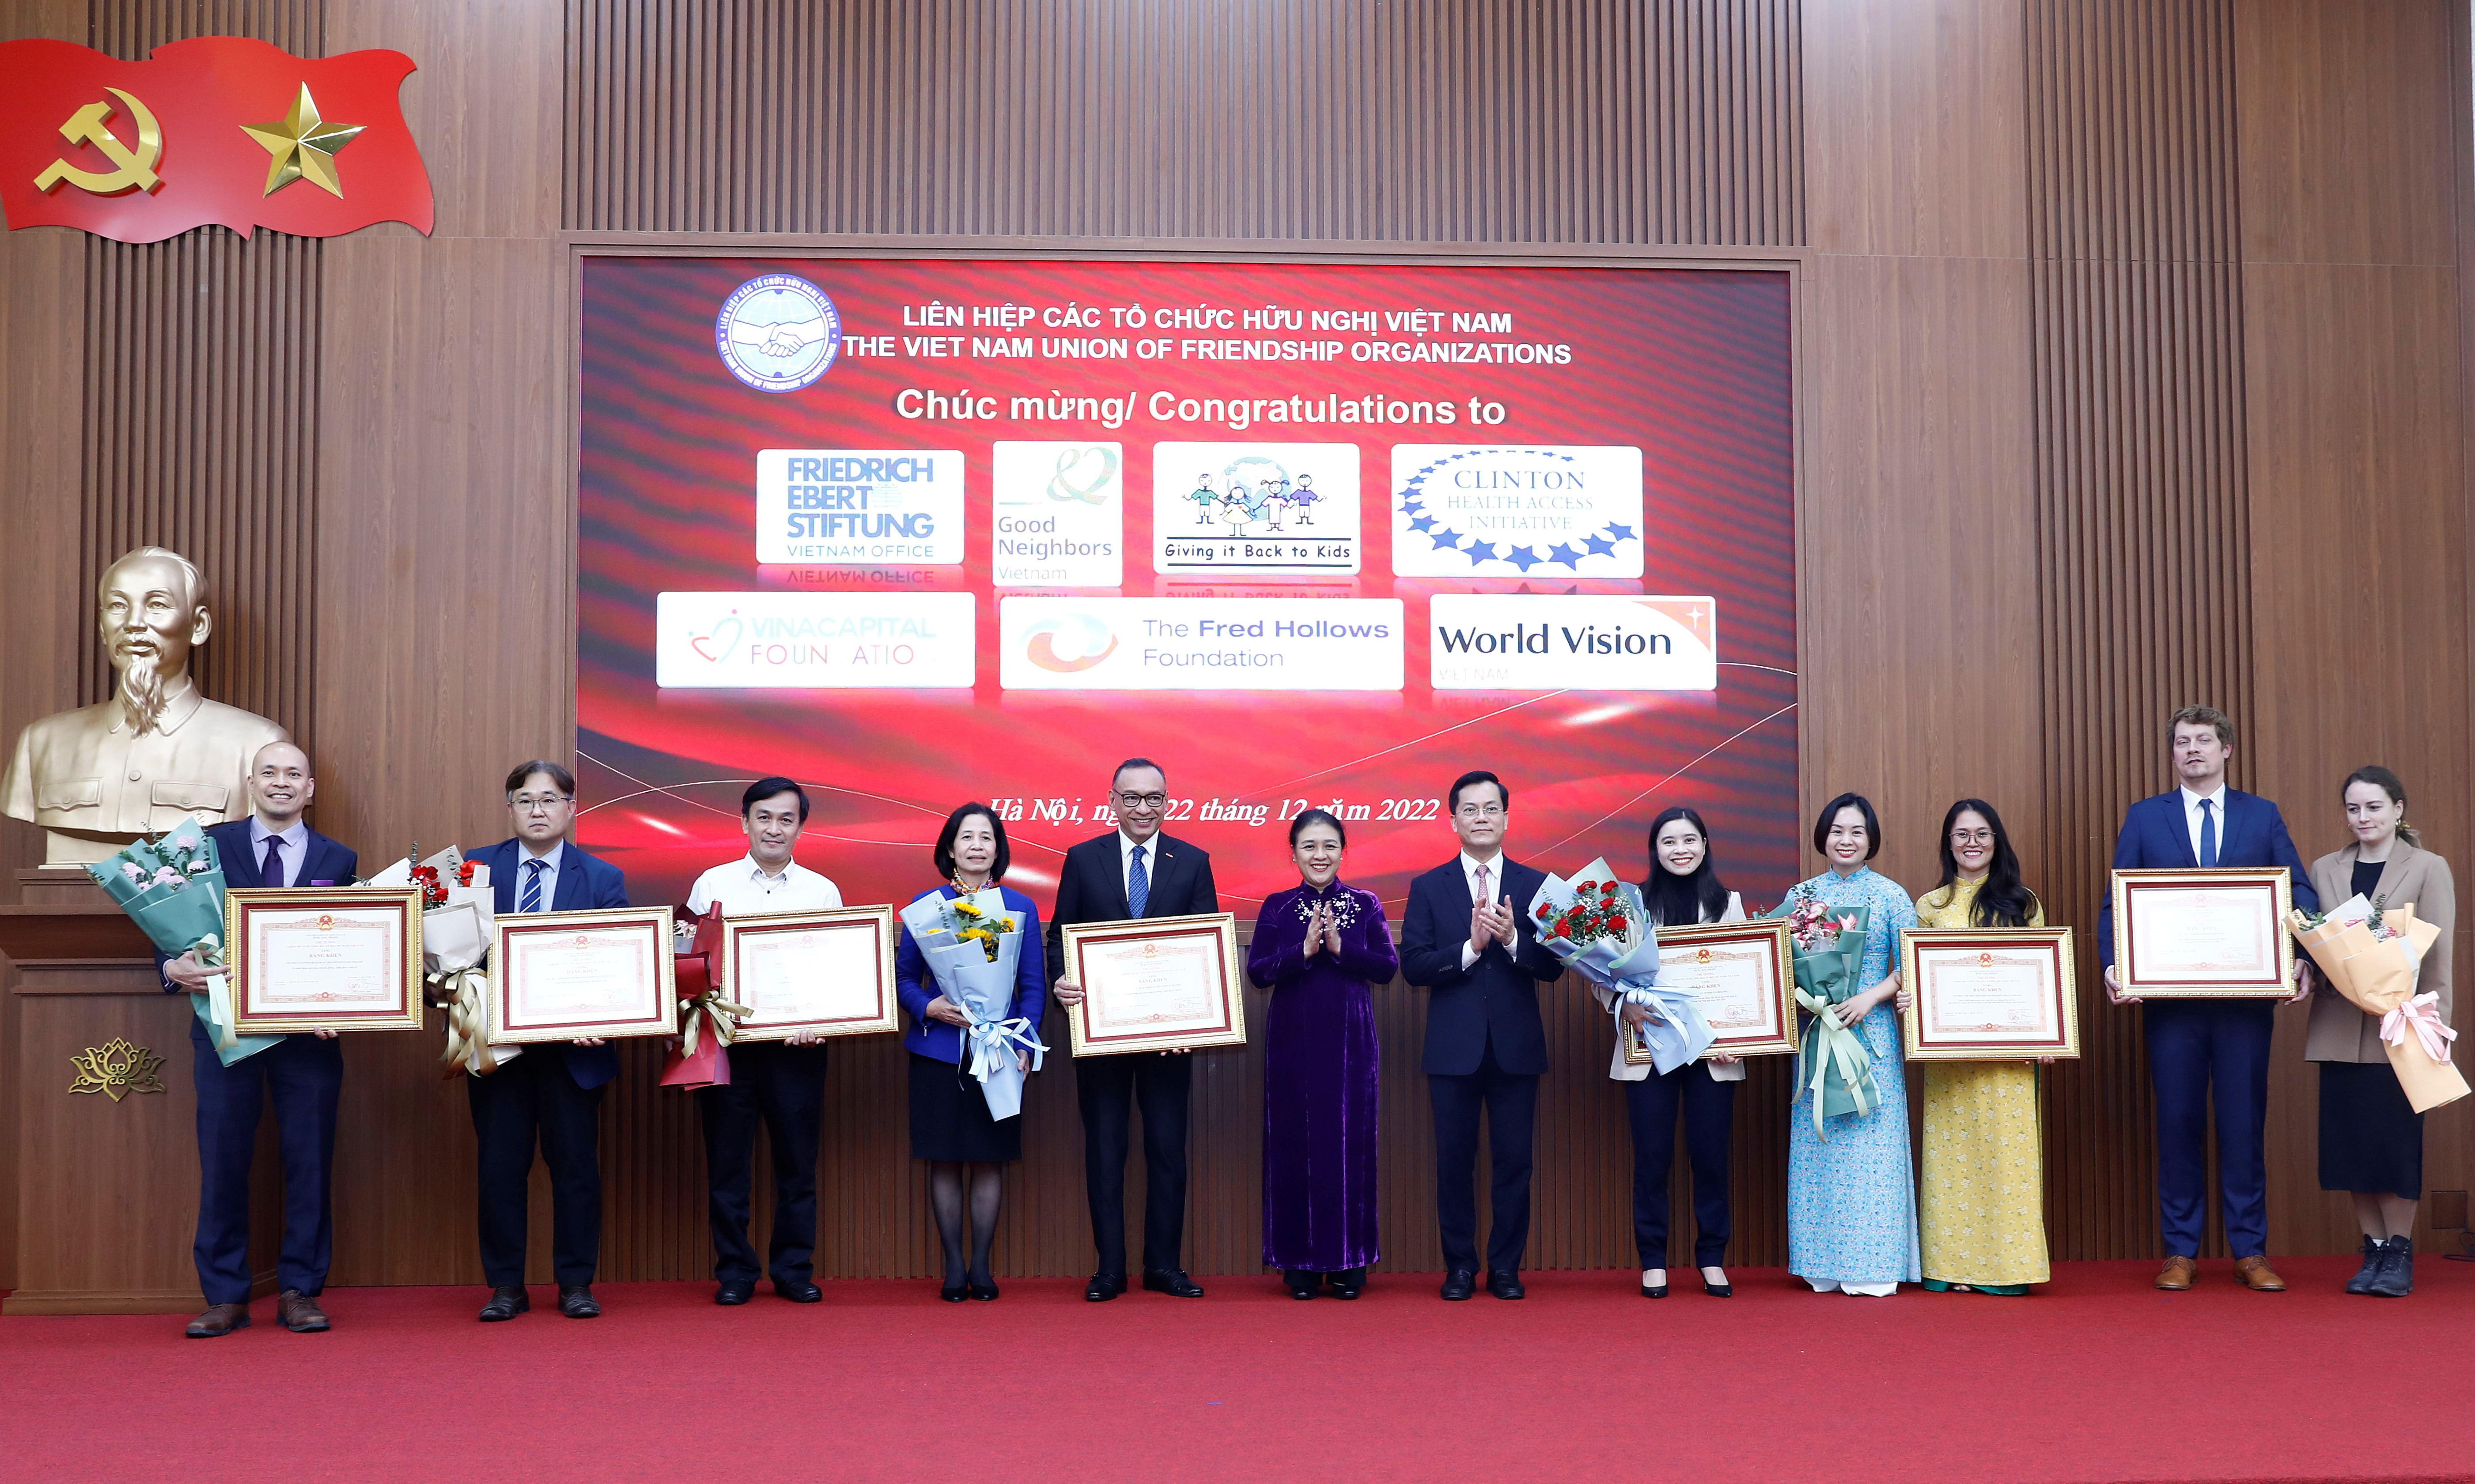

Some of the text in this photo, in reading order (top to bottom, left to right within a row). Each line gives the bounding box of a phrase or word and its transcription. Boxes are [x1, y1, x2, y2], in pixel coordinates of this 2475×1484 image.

[904, 300, 1511, 337] LIÊN HIỆP CÁC TỔ CHỨC HỮU NGHỊ VIỆT NAM
[842, 336, 1571, 364] THE VIET NAM UNION OF FRIENDSHIP ORGANIZATIONS
[897, 389, 1505, 430] Chúc mừng/ Congratulations to
[787, 457, 934, 483] FRIEDRICH
[1454, 470, 1585, 489] CLINTON
[787, 485, 873, 510] EBERT
[1448, 496, 1593, 510] HEALTH ACCESS
[787, 512, 935, 539] STIFTUNG
[998, 516, 1055, 533] Good
[1470, 516, 1572, 529] INITIATIVE
[787, 545, 934, 557] VIETNAM OFFICE
[999, 538, 1112, 560] Neighbors
[1165, 544, 1350, 560] Giving it Back to Kids
[999, 566, 1067, 580] Vietnam
[752, 617, 937, 638] VINACAPITAL
[1143, 620, 1389, 638] The Fred Hollows
[1438, 623, 1671, 655] World Vision
[1144, 649, 1283, 667] Foundation
[1474, 668, 1509, 680] NAM
[991, 798, 1023, 821] Hà
[1028, 798, 1083, 826] Nội,
[1164, 799, 1194, 820] 22
[1199, 798, 1270, 827] tháng
[1276, 799, 1308, 820] 12
[1375, 799, 1441, 820] 2022
